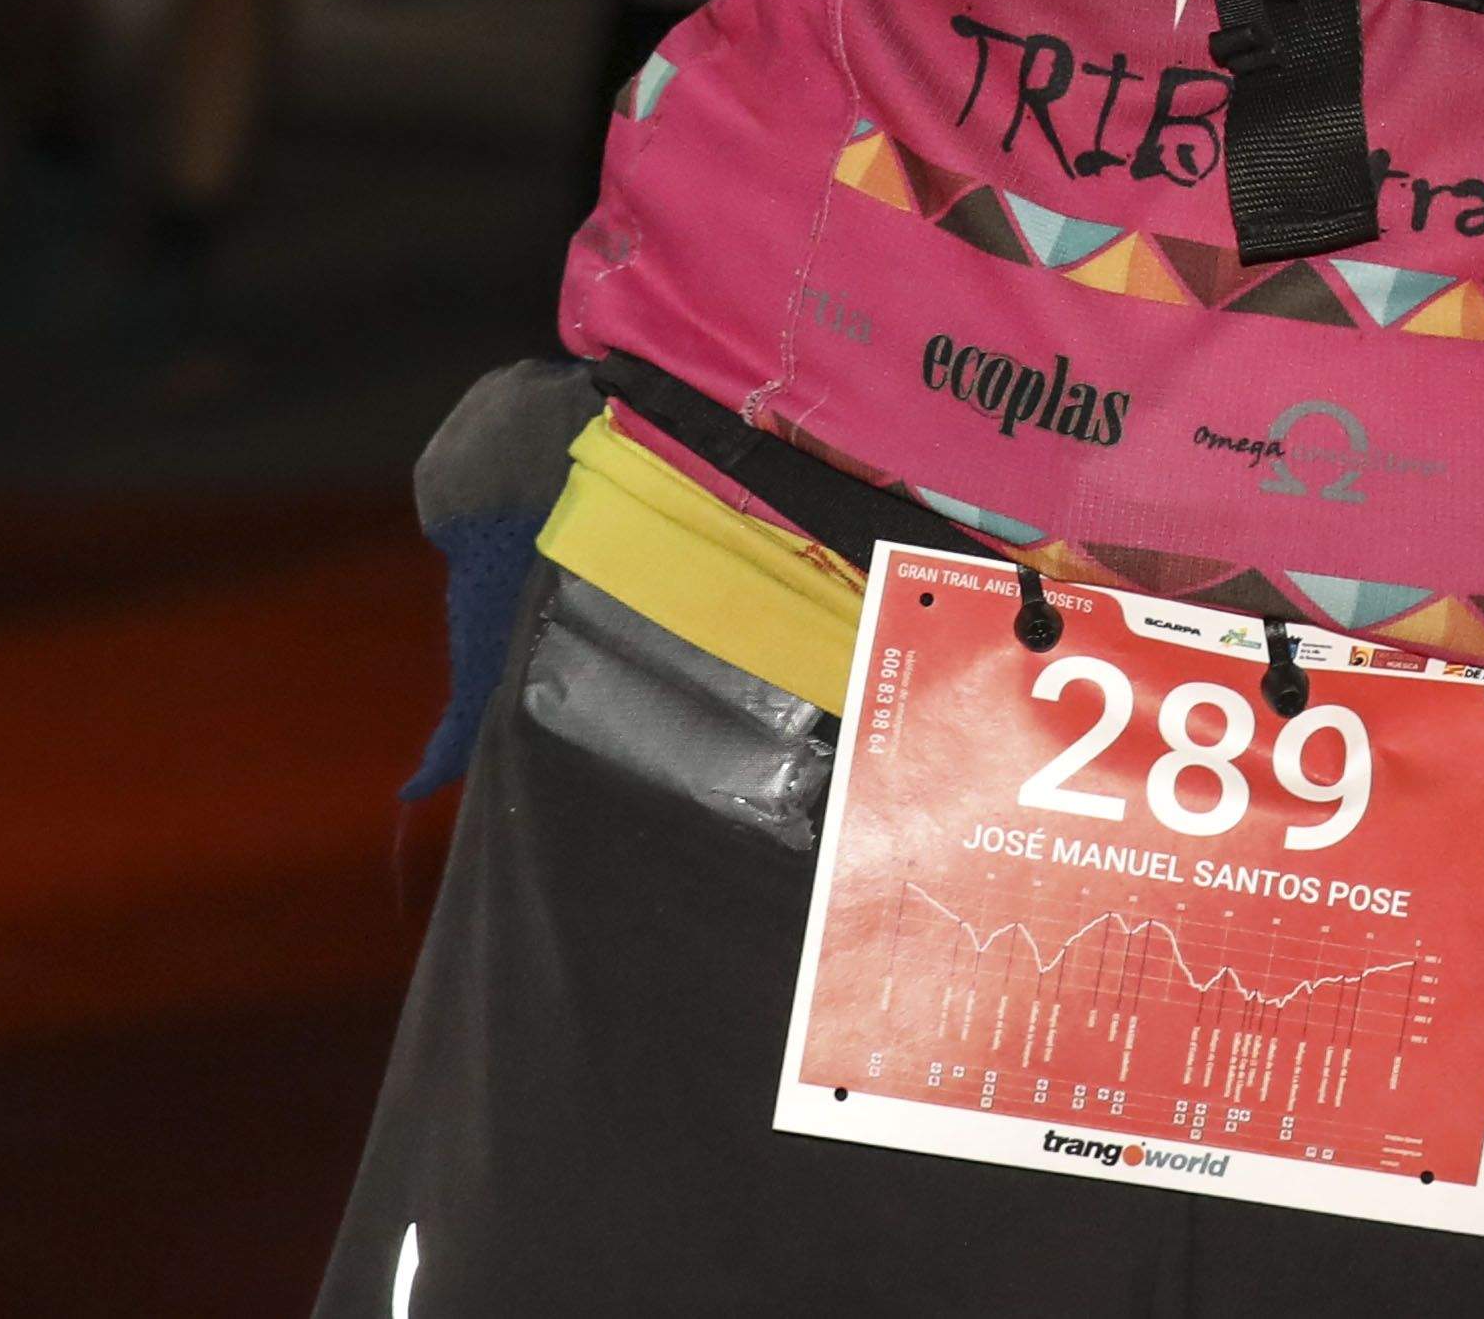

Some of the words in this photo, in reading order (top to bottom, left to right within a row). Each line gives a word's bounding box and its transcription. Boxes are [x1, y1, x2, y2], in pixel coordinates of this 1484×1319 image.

[920, 330, 1132, 447] ecoplas
[897, 561, 938, 584] GRAN
[940, 569, 982, 592] TRAIL
[1143, 616, 1202, 638] SCARPA
[883, 647, 903, 677] 606
[876, 681, 896, 706] 83
[871, 708, 891, 730] 98
[1016, 654, 1373, 852] 289
[962, 823, 1044, 861] JOSÉ
[1052, 836, 1185, 885] MANUEL
[1193, 860, 1320, 907] SANTOS
[1327, 879, 1412, 919] POSE
